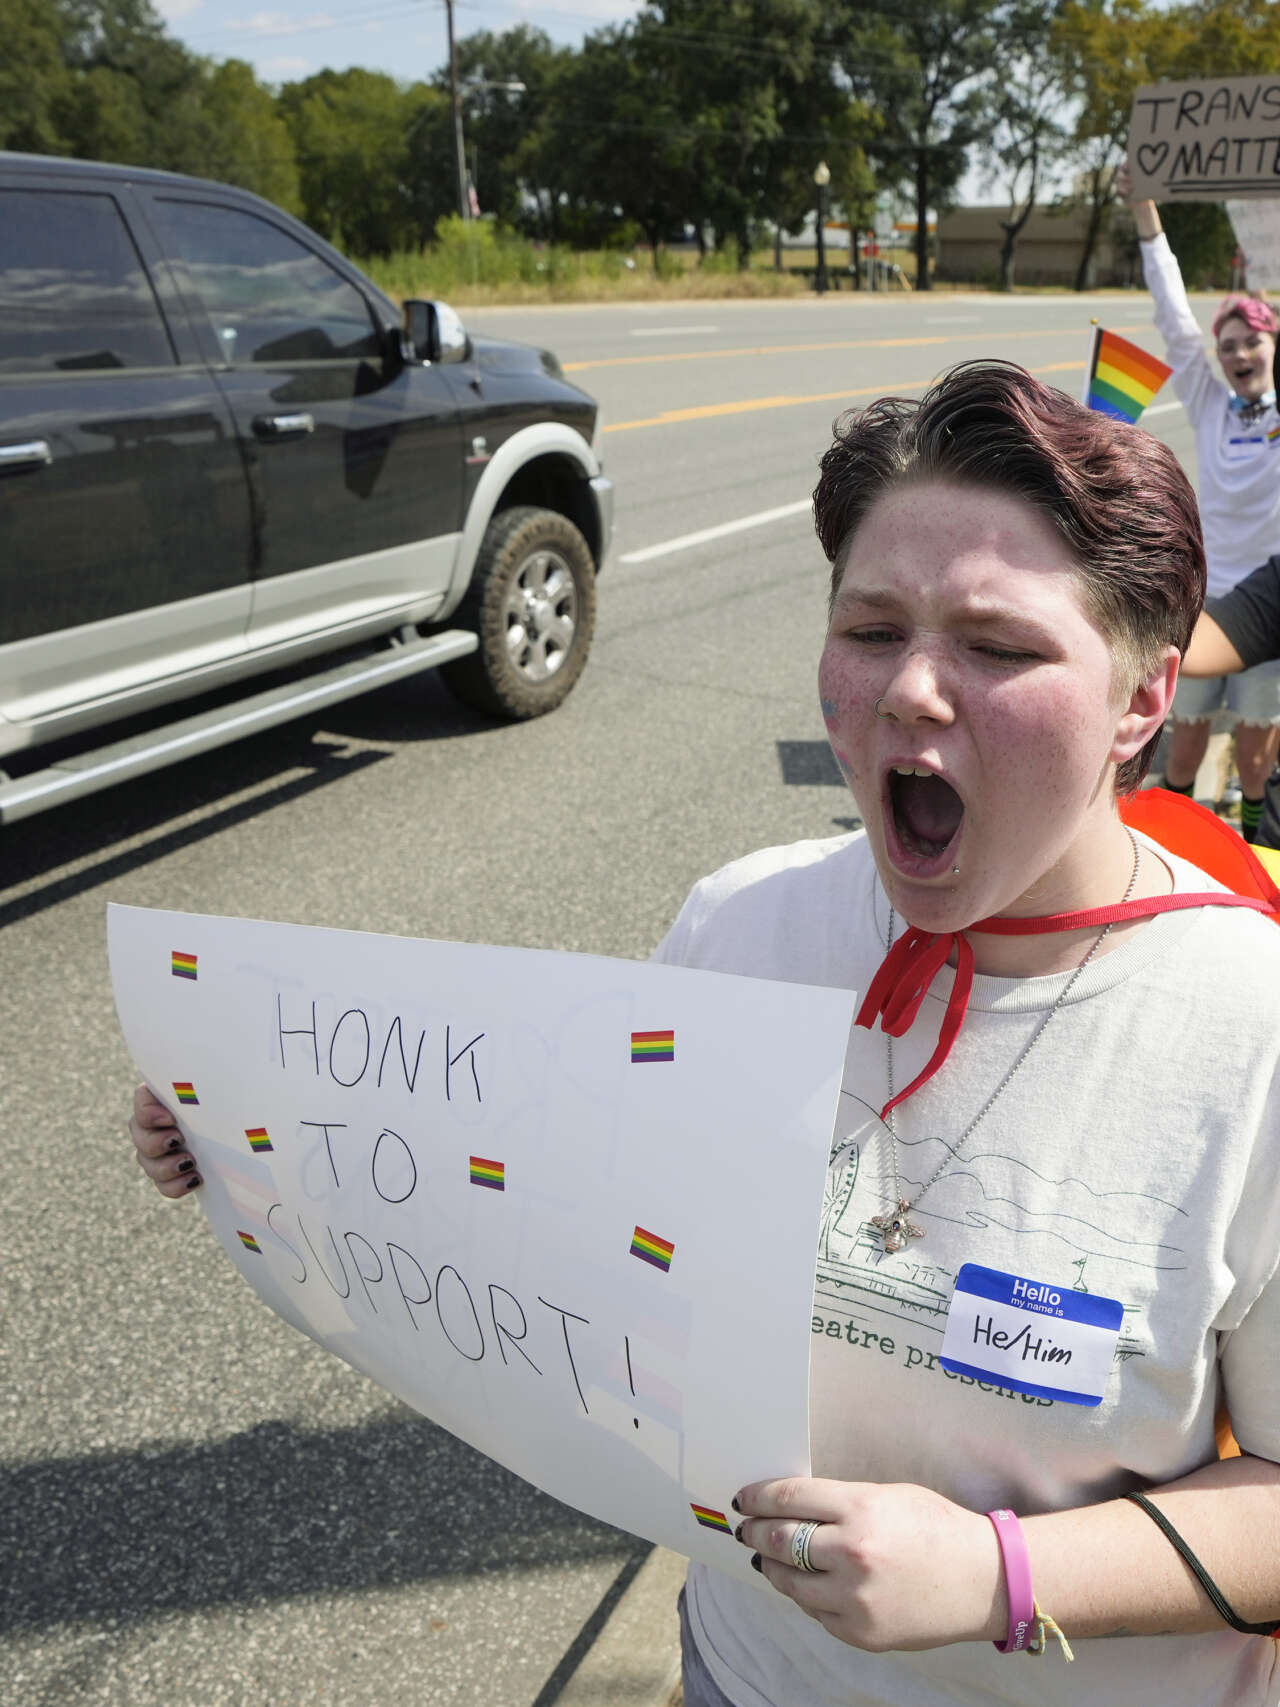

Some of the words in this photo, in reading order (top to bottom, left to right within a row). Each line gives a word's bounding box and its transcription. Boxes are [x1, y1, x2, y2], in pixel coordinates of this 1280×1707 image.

[276, 992, 486, 1103] HONK
[300, 1120, 418, 1204] TO
[267, 1203, 640, 1431] SUPPORT!
[1011, 1297, 1026, 1308] my
[1027, 1302, 1053, 1314] name
[1055, 1307, 1064, 1317] is
[1012, 1279, 1061, 1306] Hello
[973, 1314, 1073, 1366] He/Him
